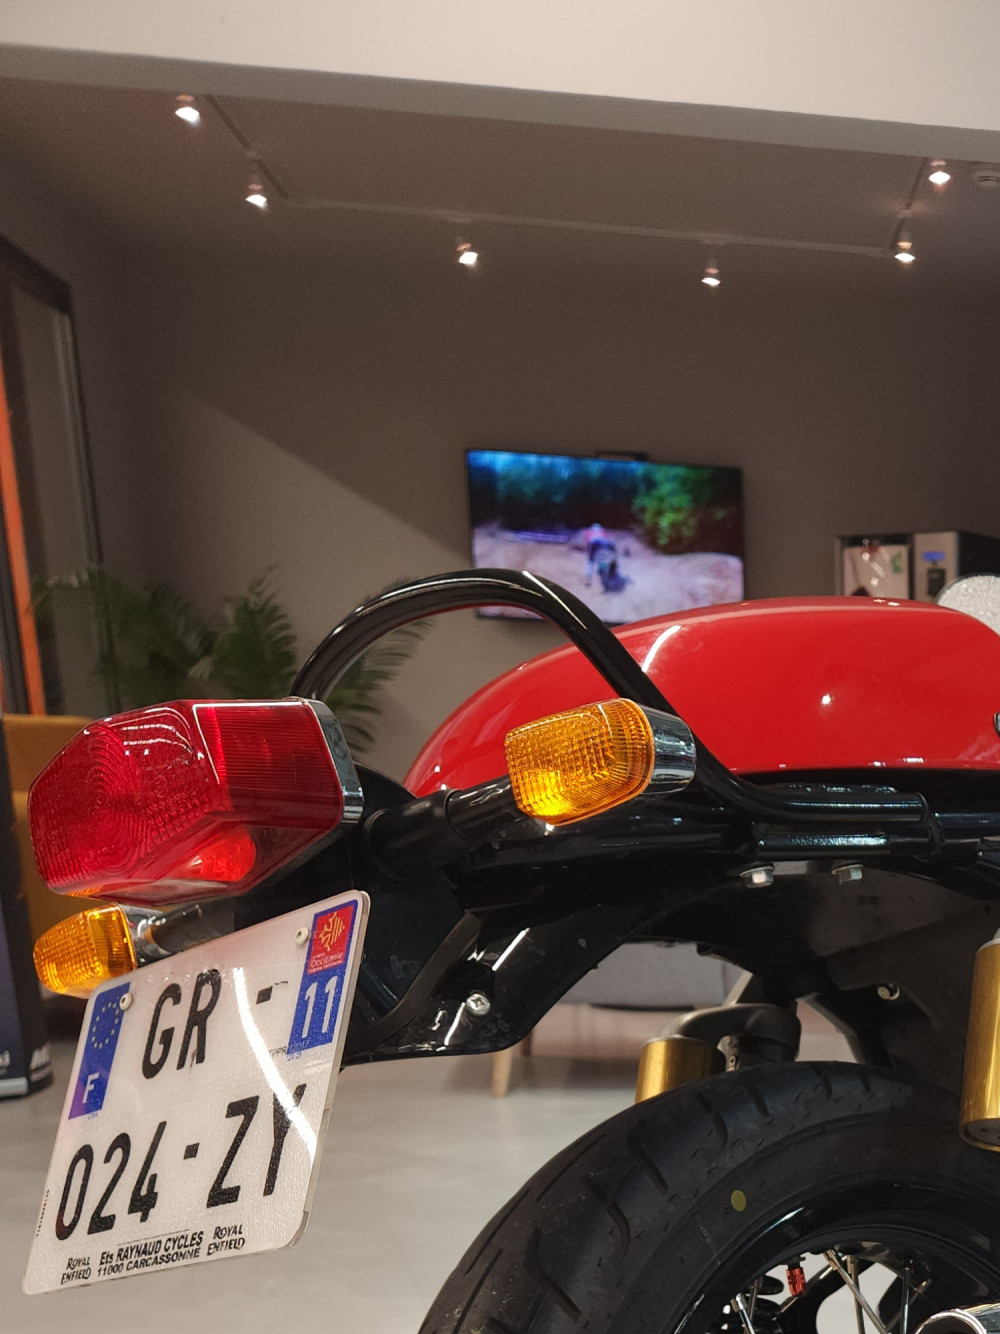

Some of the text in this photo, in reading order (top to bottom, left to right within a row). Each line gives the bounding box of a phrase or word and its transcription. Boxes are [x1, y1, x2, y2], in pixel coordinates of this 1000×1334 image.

[299, 975, 338, 1039] 11
[83, 1072, 99, 1104] F
[213, 1224, 243, 1239] ROYAL
[100, 1231, 204, 1266] Ets RAYNAUD CYCLES
[207, 1237, 246, 1256] ENFIELD
[66, 1256, 91, 1270] ROYAL
[97, 1248, 201, 1277] 11000 CARCASSONNE
[61, 1267, 92, 1285] ENFIELD
